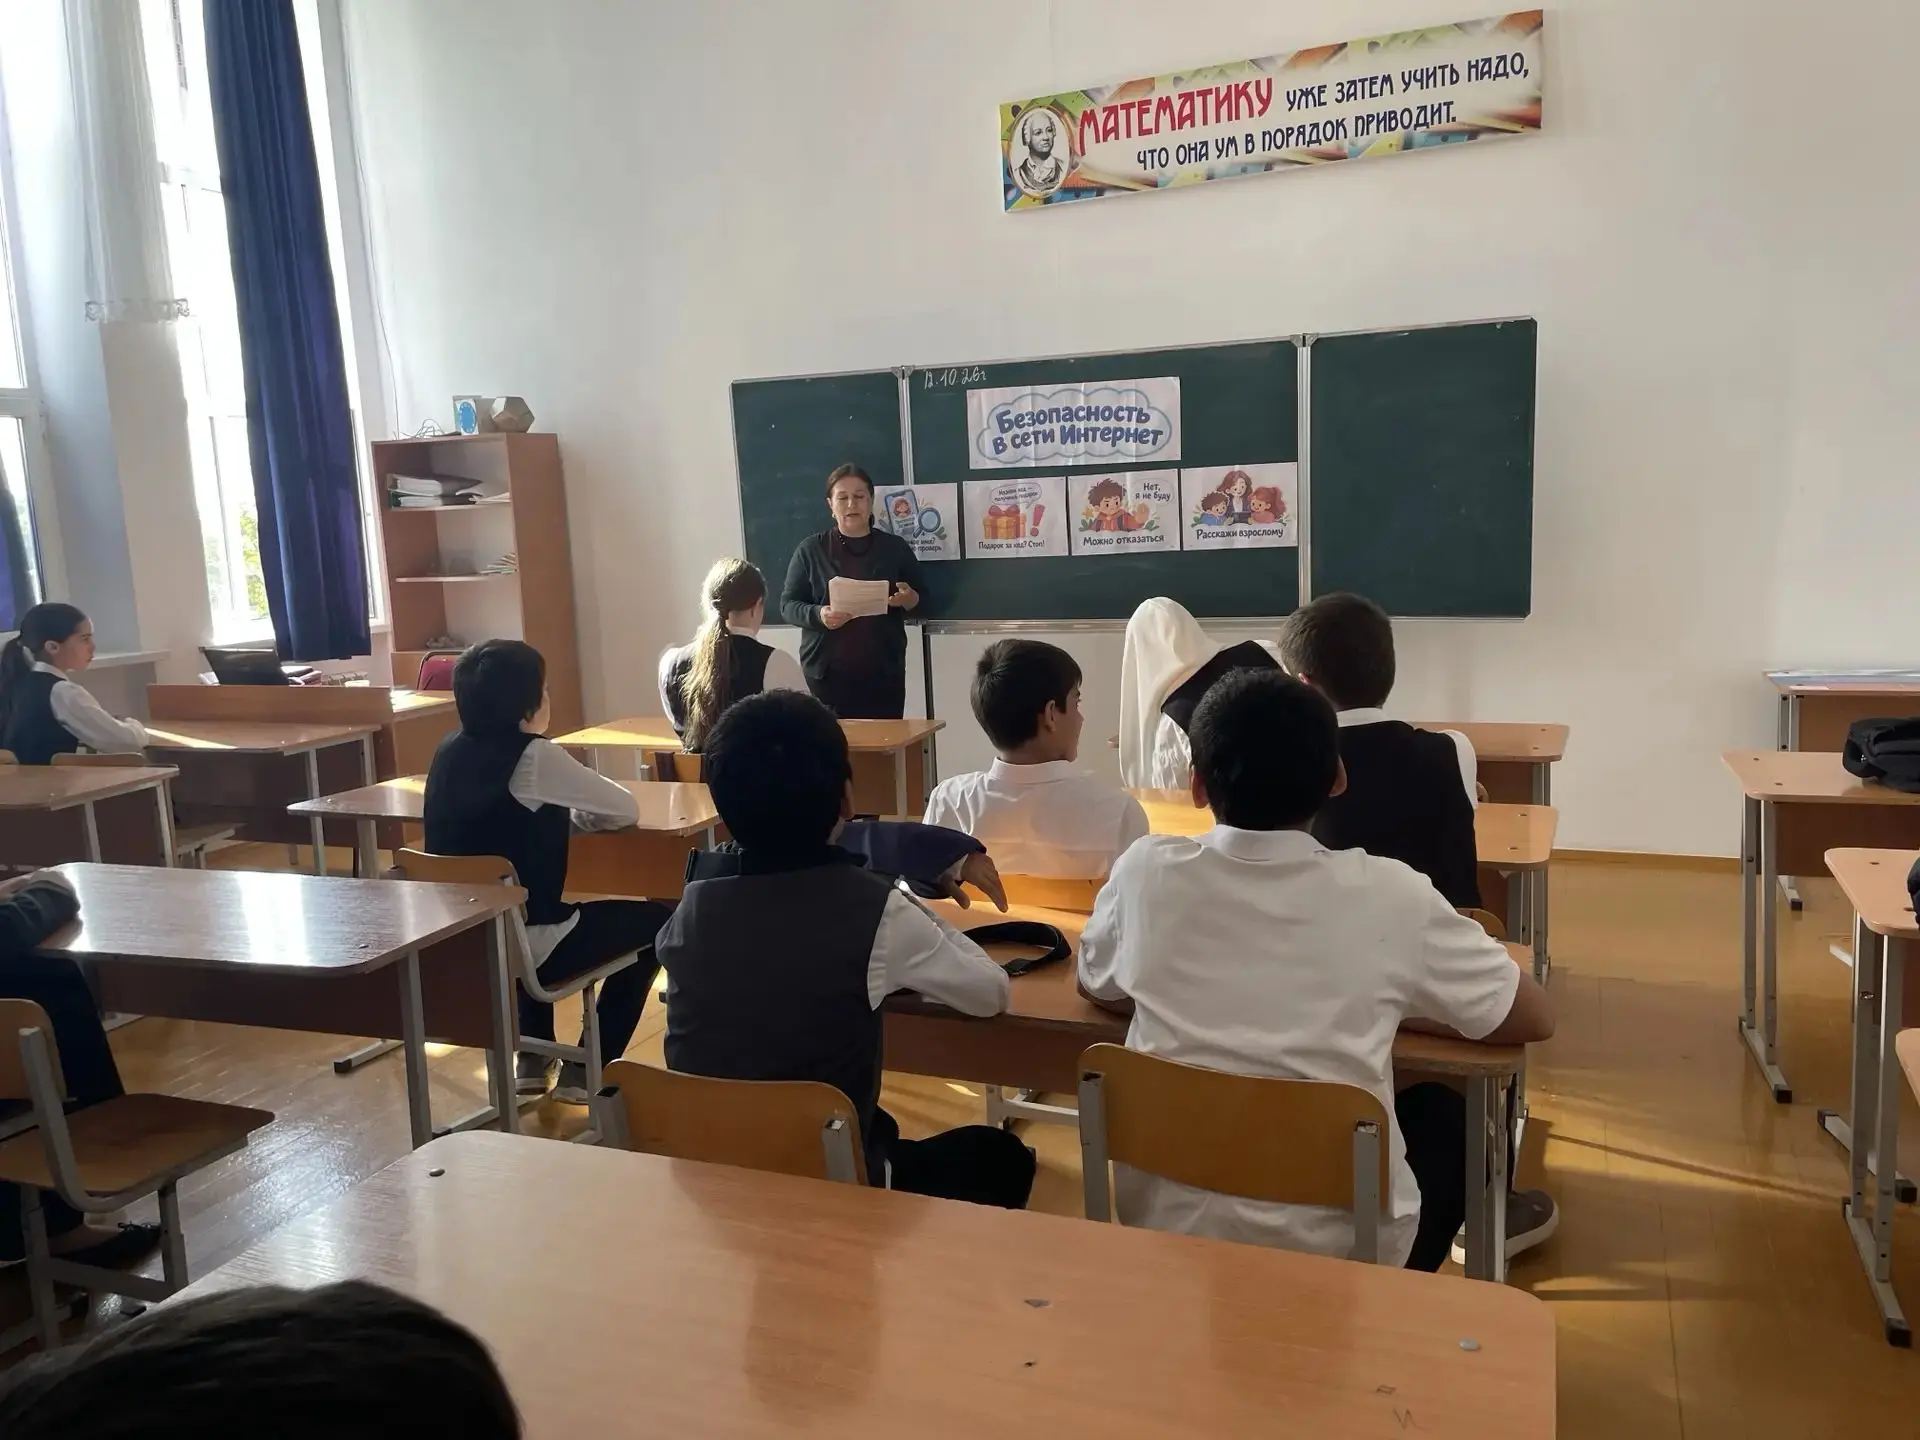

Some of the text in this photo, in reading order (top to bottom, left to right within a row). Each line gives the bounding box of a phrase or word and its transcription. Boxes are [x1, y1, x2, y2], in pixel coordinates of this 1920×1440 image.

[1078, 52, 1529, 156] МАТЕМАТИКУ УЖЕ ЗАТЕМ УЧИТЬ НАДО,
[1137, 101, 1457, 171] ЧТО ОНА УМ В ПОРЯДОК ПРИВОДИТ.
[996, 405, 1150, 434] Безопасность
[992, 424, 1163, 455] в сети Интернет
[1143, 482, 1160, 492] Нет,
[1142, 492, 1152, 500] не
[1153, 490, 1171, 501] буду
[1083, 534, 1165, 546] Можно отказаться
[1196, 528, 1284, 540] Расскажи взрослому
[978, 541, 1004, 550] Подарок
[1013, 540, 1028, 549] код?
[1028, 539, 1045, 548] Стоп!
